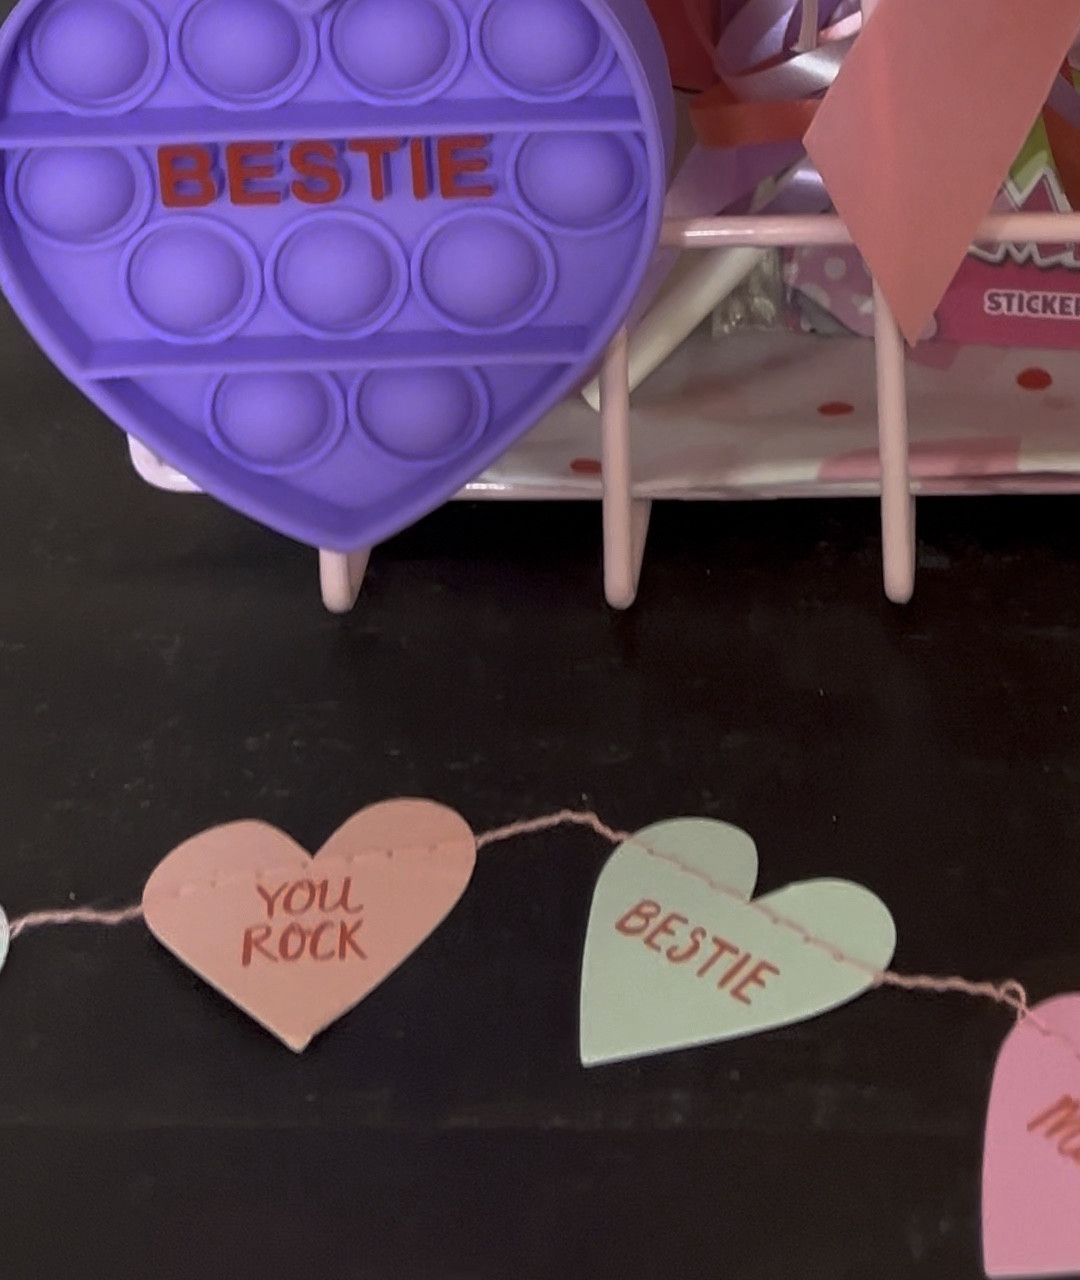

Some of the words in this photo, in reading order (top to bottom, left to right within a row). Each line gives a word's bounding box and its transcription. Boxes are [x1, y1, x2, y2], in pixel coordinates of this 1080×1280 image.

[156, 133, 497, 209] BESTIE
[256, 877, 364, 918] YOU
[241, 920, 368, 967] ROCK
[614, 898, 781, 1007] BESTIE
